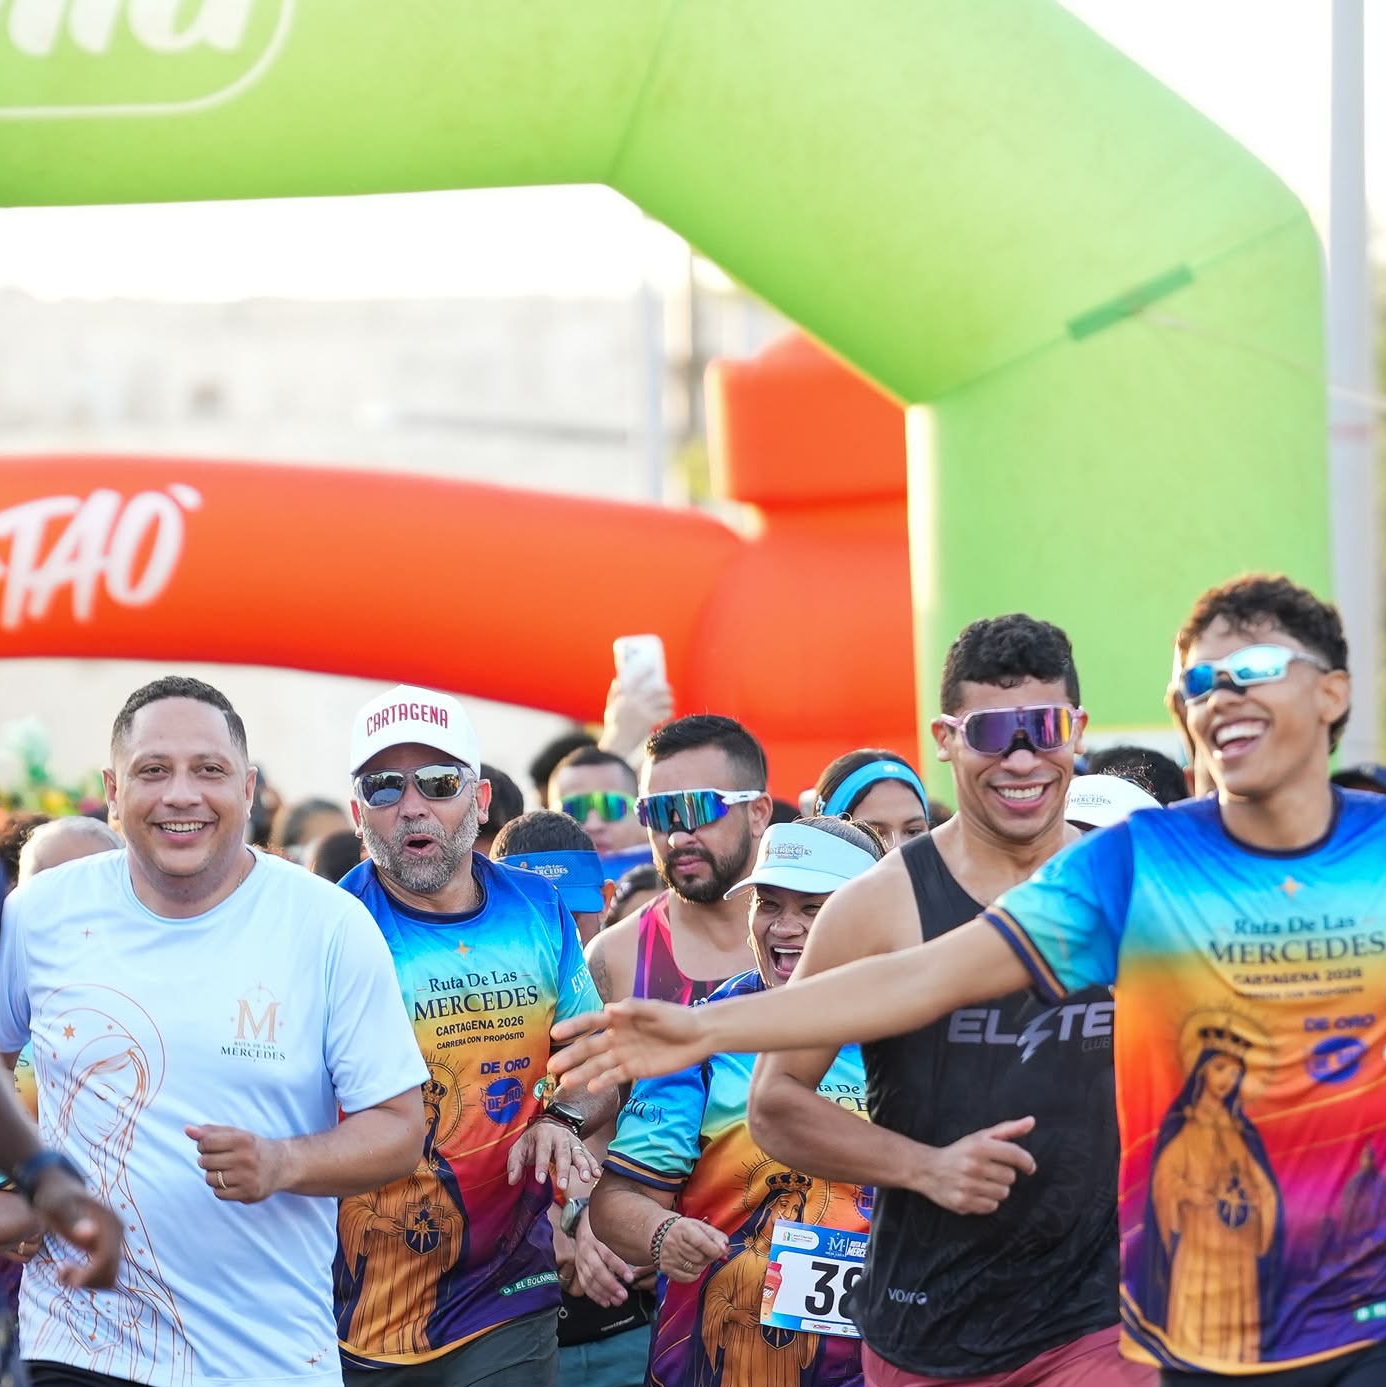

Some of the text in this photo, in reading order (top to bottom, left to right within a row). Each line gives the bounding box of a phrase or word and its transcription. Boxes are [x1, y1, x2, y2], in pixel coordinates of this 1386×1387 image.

[366, 702, 449, 737] CARTAGENA
[1288, 916, 1316, 933] De
[1322, 914, 1356, 931] Las
[1207, 930, 1386, 965] MERCEDES
[428, 970, 518, 993] Ruta De Las
[414, 985, 539, 1021] MERCEDES
[234, 999, 282, 1044] M
[435, 1015, 524, 1036] CARTAGENA 2026
[436, 1039, 467, 1050] CARRERA
[466, 1035, 482, 1044] CON
[220, 1046, 286, 1061] MERCEDES
[480, 1056, 531, 1075] DE ORO
[818, 1083, 861, 1095] ta De
[847, 1247, 866, 1258] MERCE
[515, 1281, 526, 1290] EL
